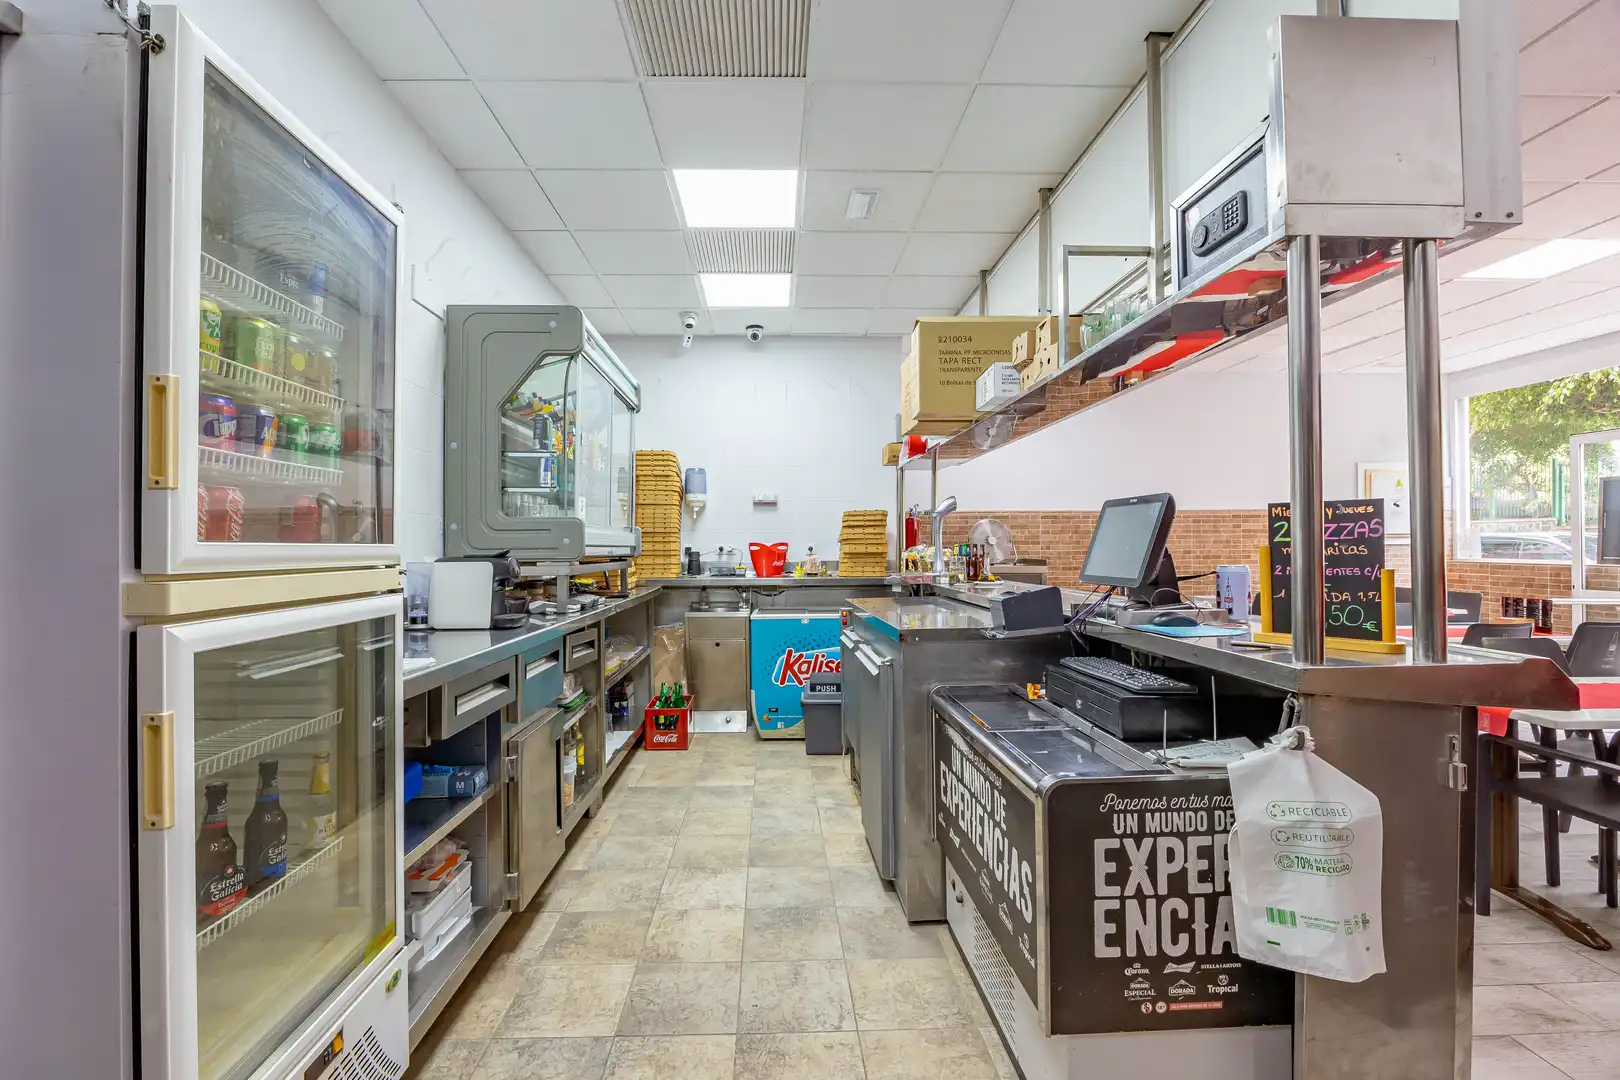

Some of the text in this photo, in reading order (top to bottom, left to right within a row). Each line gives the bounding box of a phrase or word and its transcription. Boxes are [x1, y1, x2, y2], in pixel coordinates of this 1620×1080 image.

[939, 356, 982, 365] TAPA RECT
[1273, 521, 1291, 542] 2
[1274, 564, 1283, 576] 2
[1273, 588, 1285, 598] 1
[653, 733, 679, 743] Coca-Cola
[951, 745, 1007, 831] UN MUNDO DE
[1100, 793, 1168, 812] Ponemos
[1170, 797, 1187, 809] en
[1189, 793, 1209, 809] tus
[1288, 807, 1348, 817] RECICLABLE
[1112, 813, 1139, 834] UN
[1145, 811, 1207, 834] MUNDO
[940, 760, 1034, 925] EXPERIENCIAS
[1295, 855, 1314, 871] 70%
[210, 872, 244, 892] Estrella
[211, 882, 243, 902] Galicia
[1094, 896, 1239, 958] ENCIA
[1124, 967, 1150, 976] Corona
[1124, 989, 1156, 997] ESPECIAL
[1207, 984, 1239, 994] Tropical
